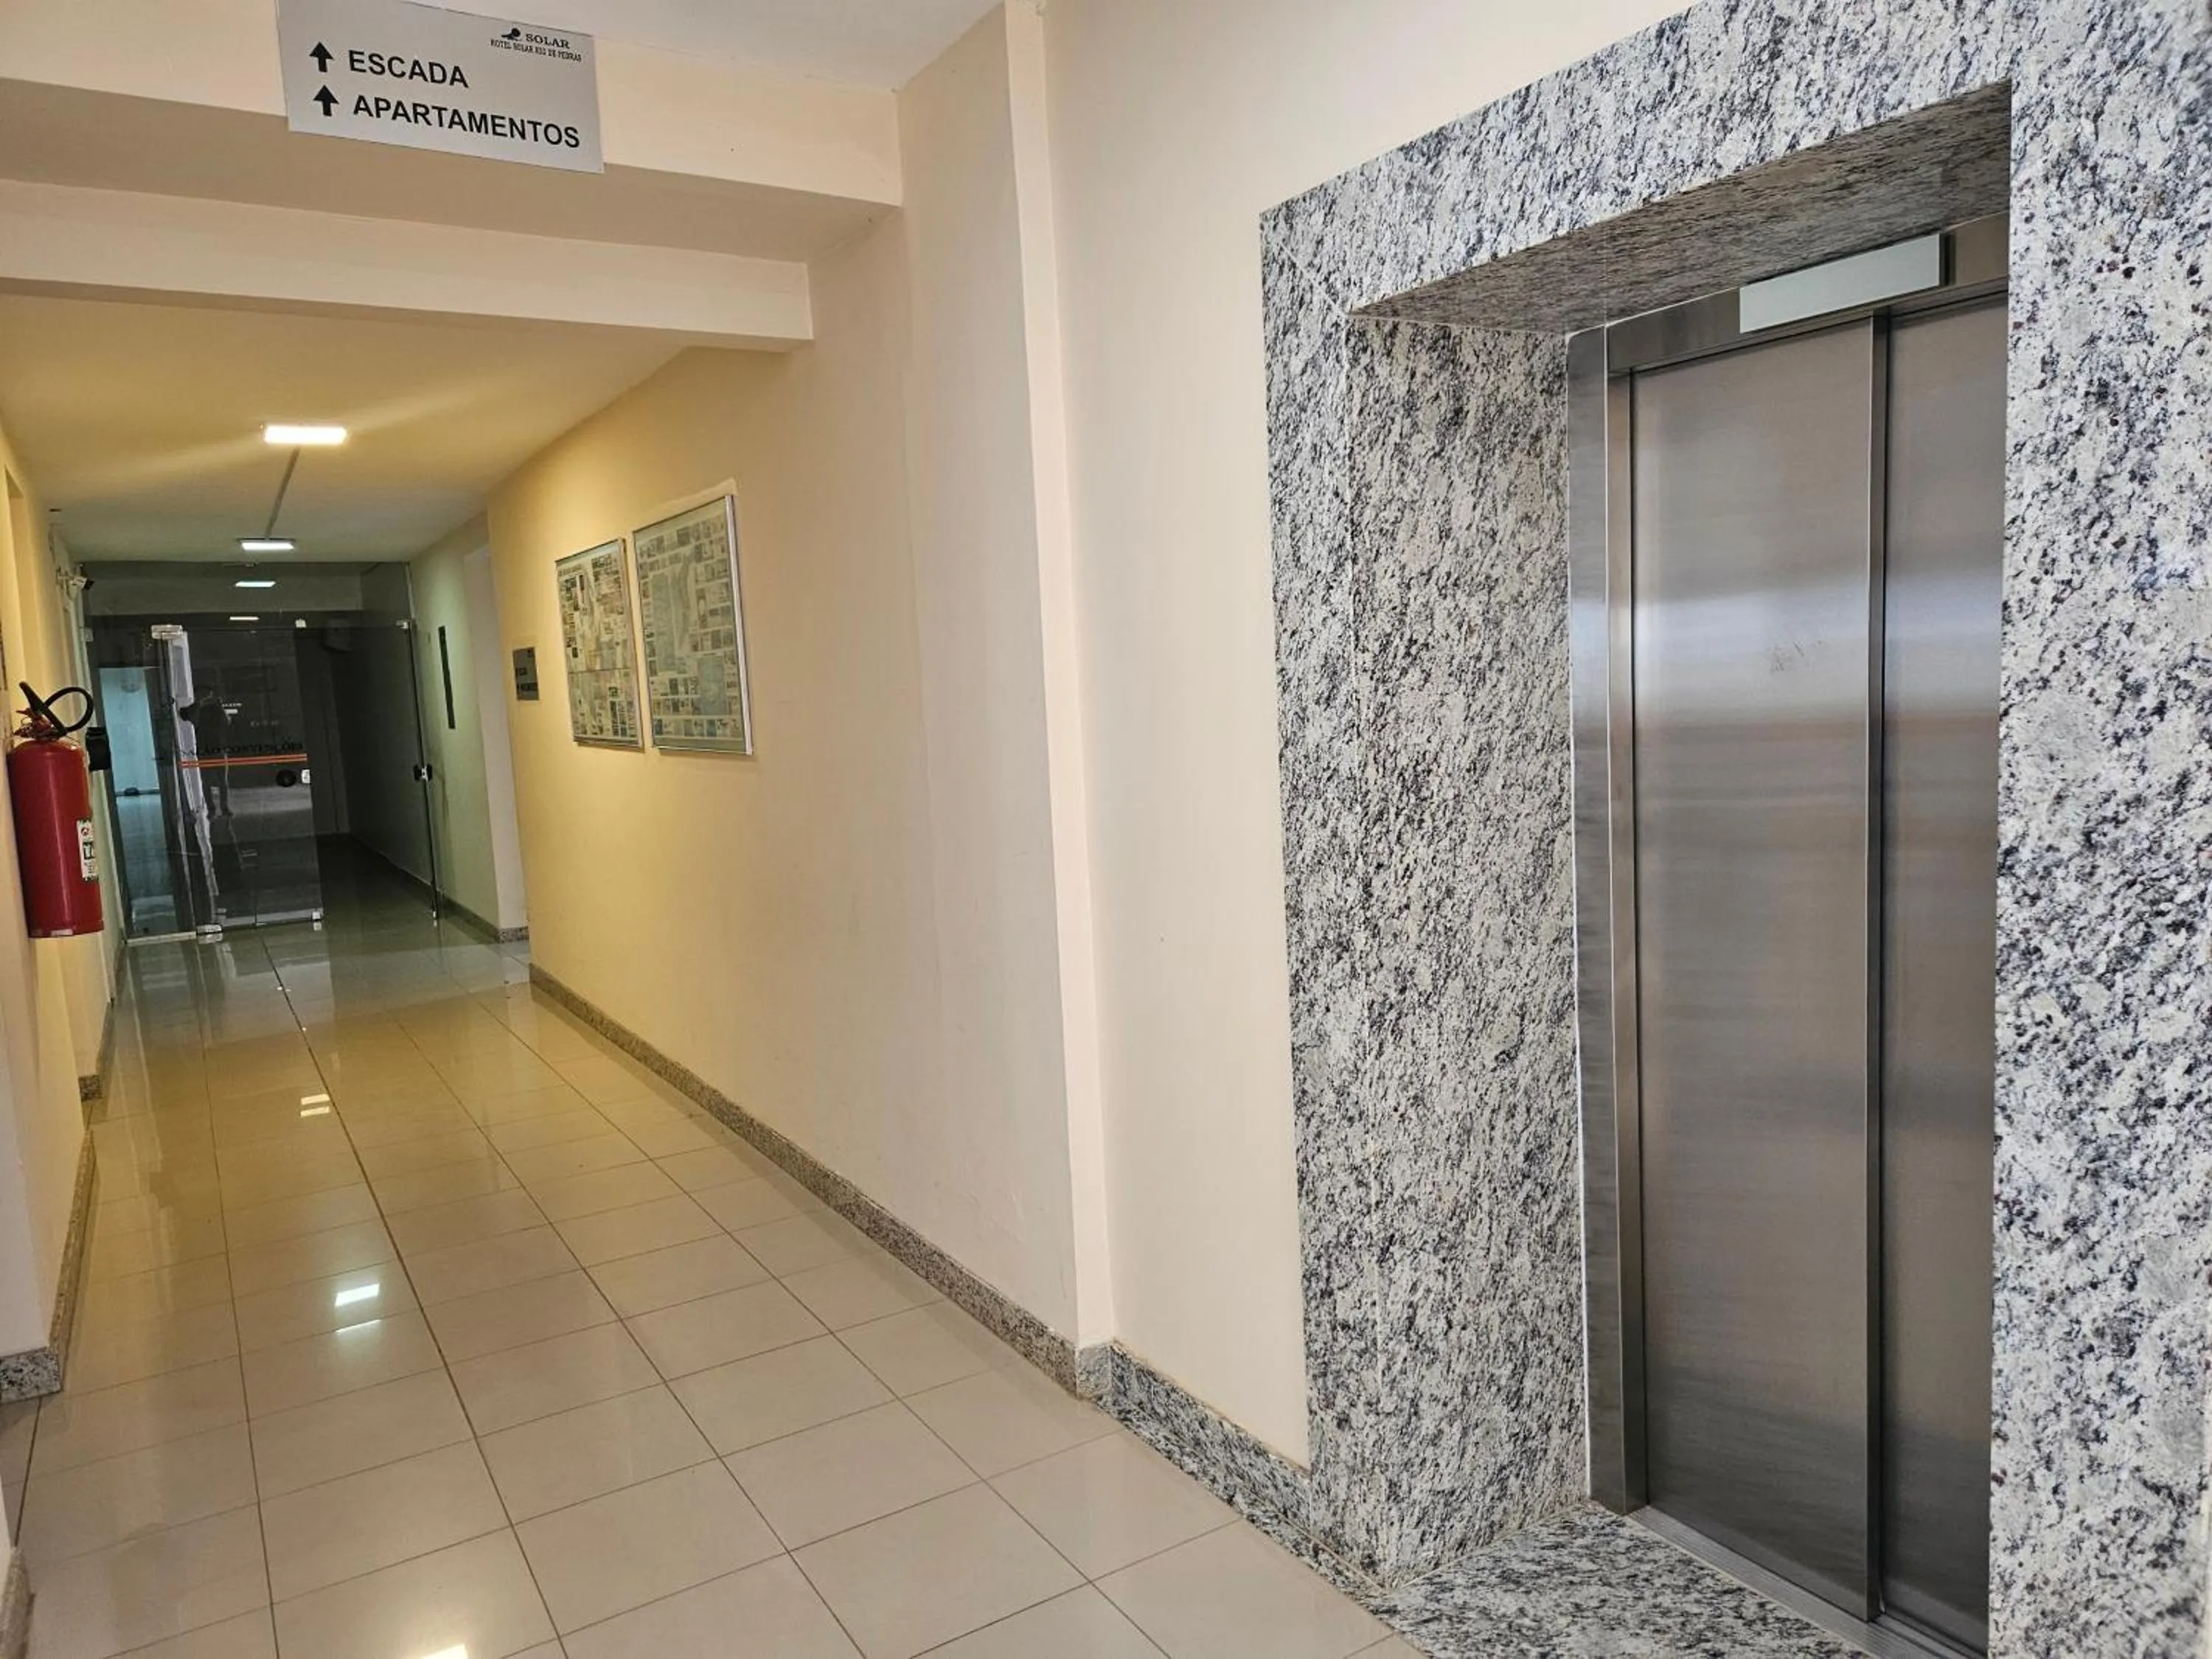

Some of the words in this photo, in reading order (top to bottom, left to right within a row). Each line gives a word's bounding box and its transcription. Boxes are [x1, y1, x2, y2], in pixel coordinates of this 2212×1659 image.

[490, 38, 512, 50] HOTEL
[525, 32, 570, 49] SOLAR
[348, 49, 470, 88] ESCADA
[352, 94, 580, 148] APARTAMENTOS
